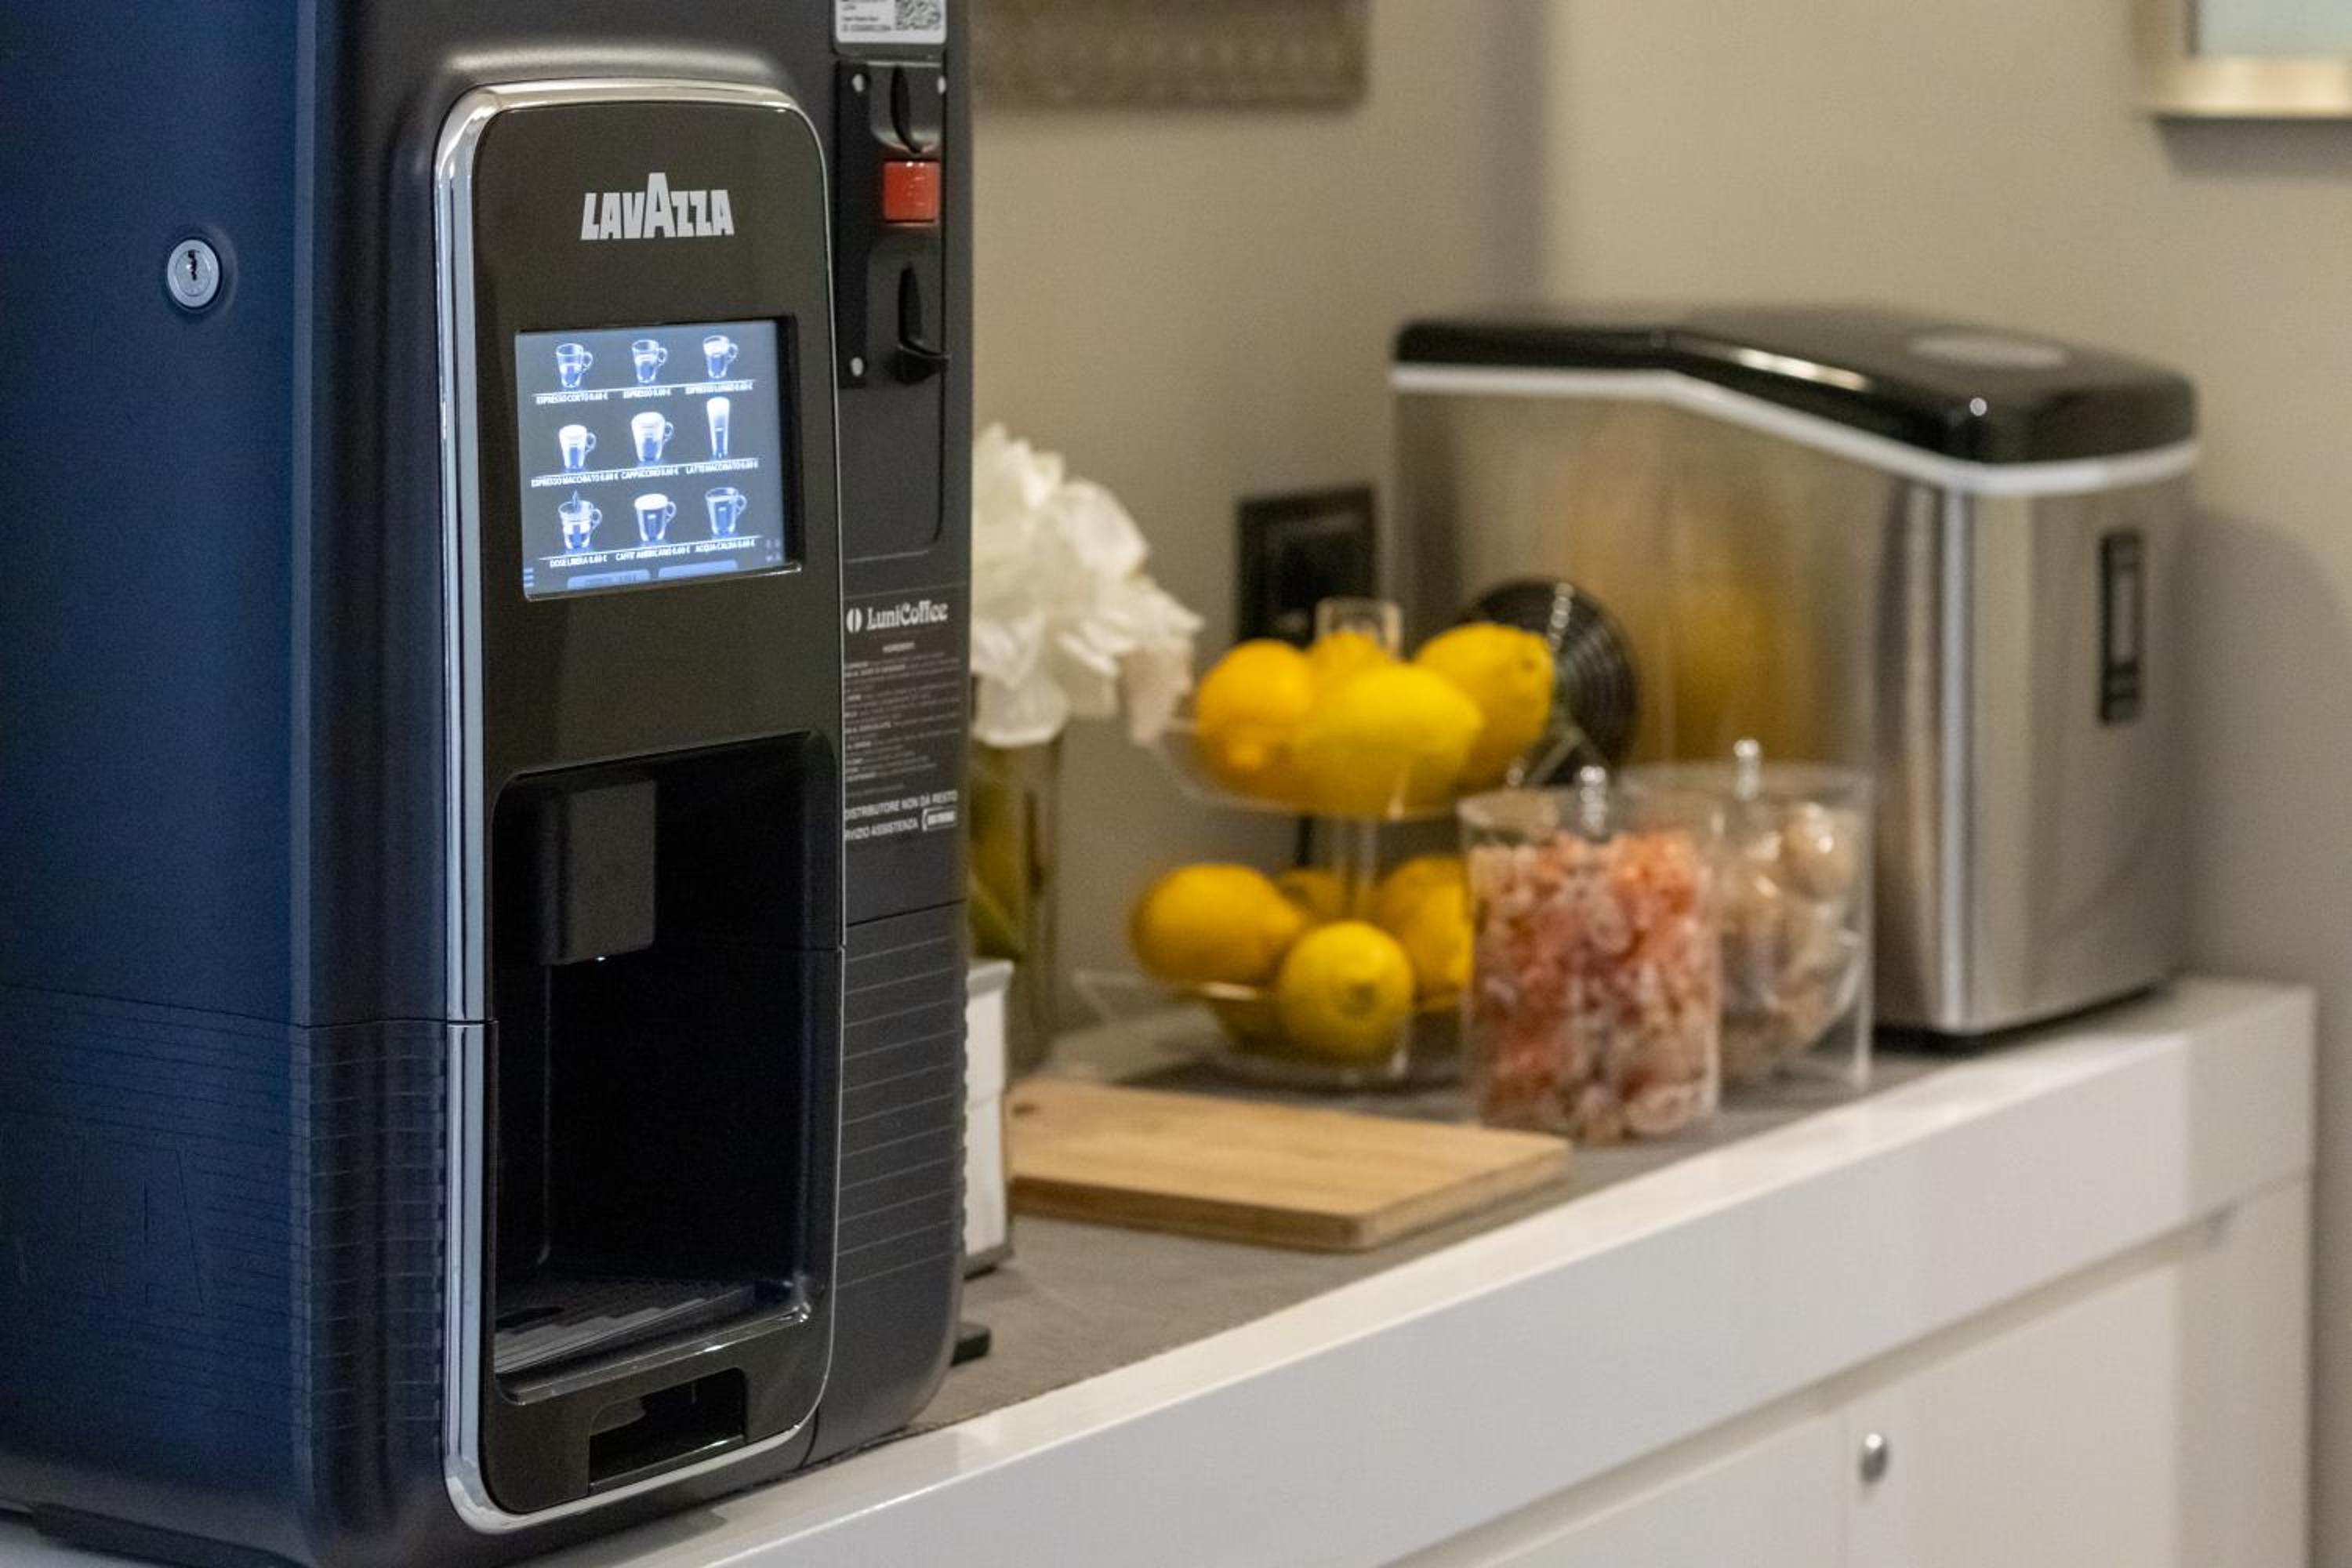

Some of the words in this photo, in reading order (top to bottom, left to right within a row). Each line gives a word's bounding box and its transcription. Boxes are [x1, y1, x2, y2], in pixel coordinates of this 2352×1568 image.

[581, 172, 735, 240] LAVAZZA
[623, 389, 652, 398] ESPRESSO
[536, 394, 566, 405] ESPRESSO
[531, 477, 561, 487] ESPRESSO
[866, 600, 949, 631] LuniCoffee
